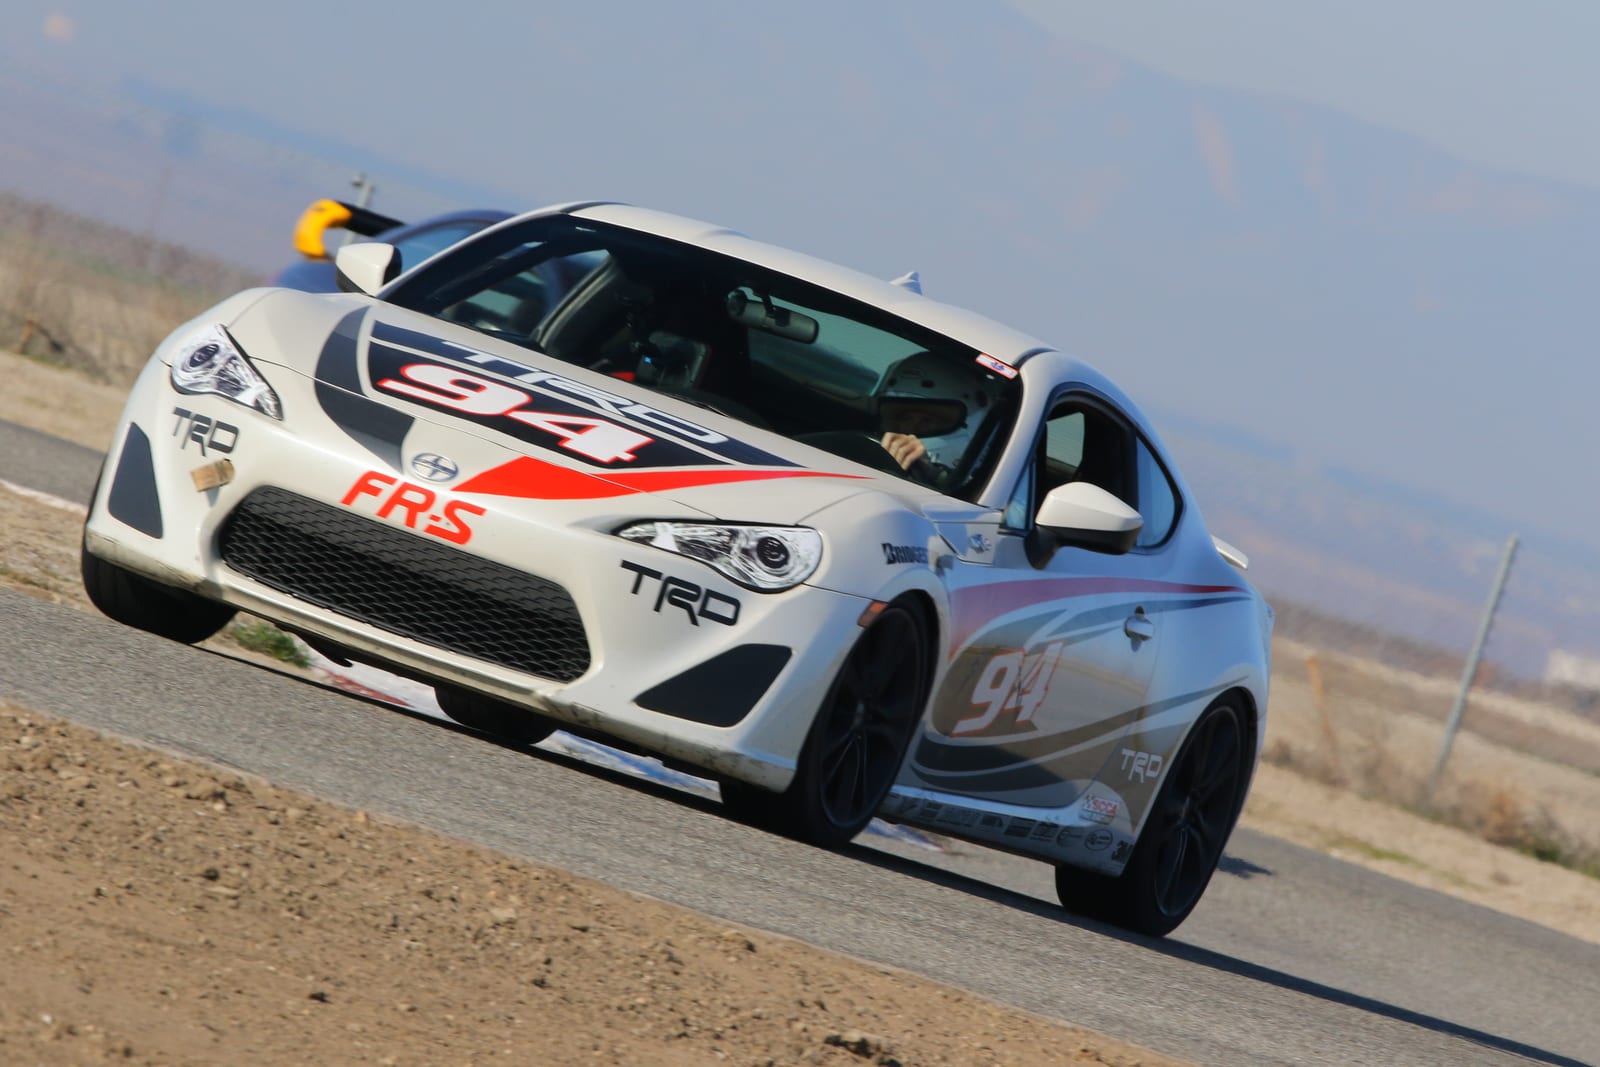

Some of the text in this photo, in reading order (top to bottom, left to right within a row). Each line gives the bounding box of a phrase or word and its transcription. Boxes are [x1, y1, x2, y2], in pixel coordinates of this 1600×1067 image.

[377, 363, 655, 464] 94
[442, 340, 730, 445] TRD
[173, 406, 240, 457] TRD
[340, 470, 488, 545] FR-S
[619, 559, 741, 627] TRD
[950, 639, 1064, 738] 94
[1120, 747, 1164, 784] TRD
